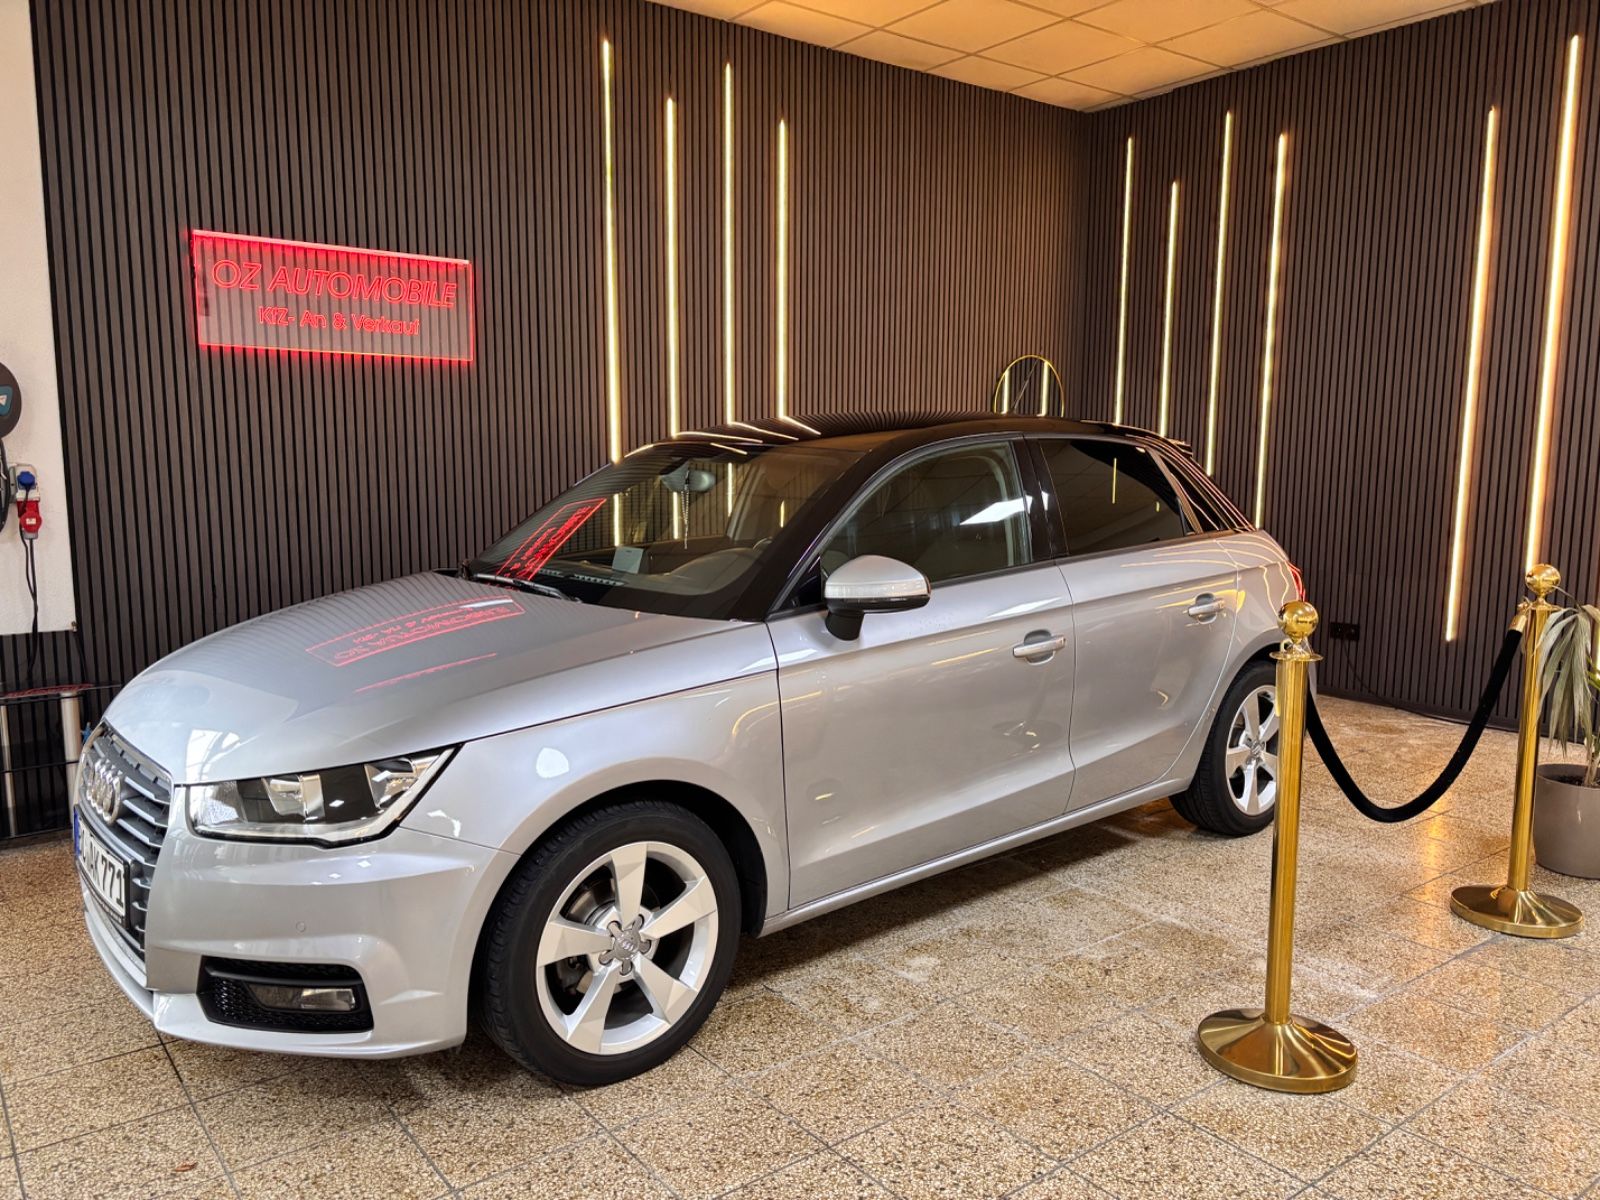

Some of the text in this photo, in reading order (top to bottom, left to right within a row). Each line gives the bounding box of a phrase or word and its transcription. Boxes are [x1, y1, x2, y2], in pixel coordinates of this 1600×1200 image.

[212, 259, 457, 308] OZ AUTOMOBILE
[300, 310, 326, 329] An
[332, 312, 347, 330] &
[351, 313, 420, 336] Verkauf
[101, 854, 124, 908] 771
